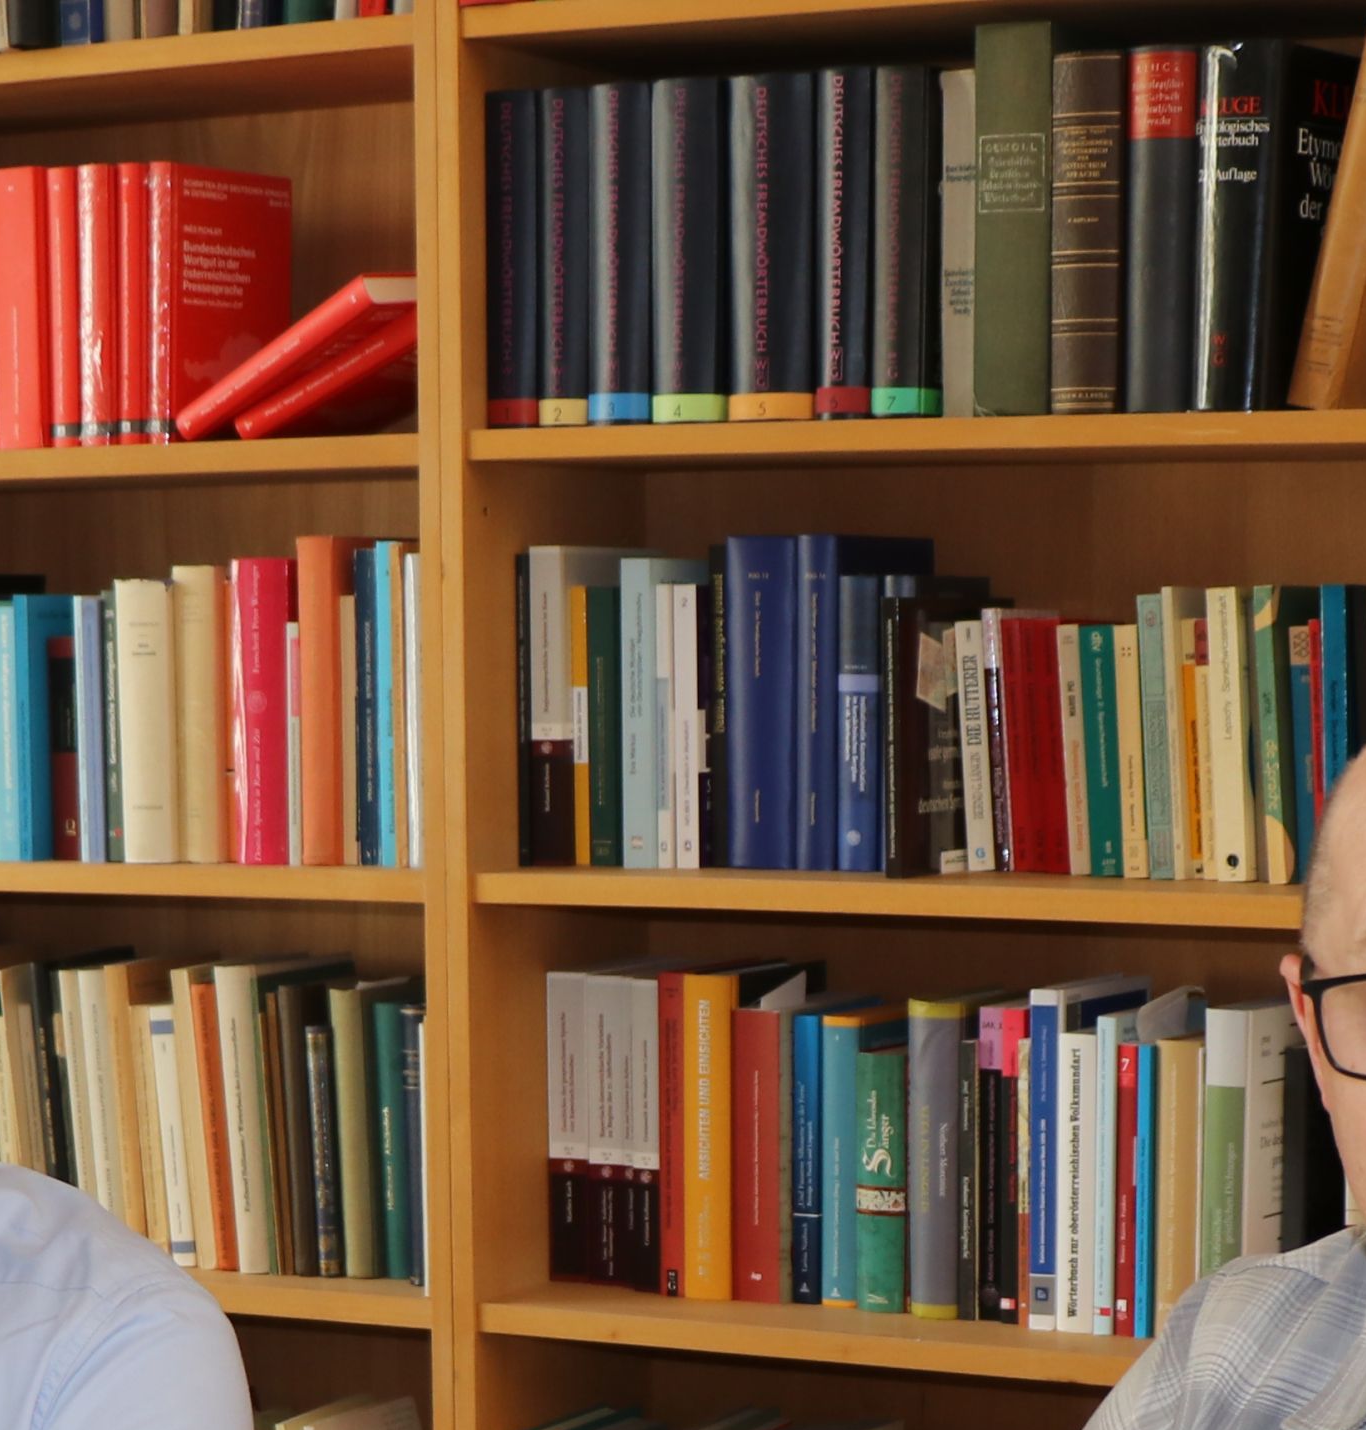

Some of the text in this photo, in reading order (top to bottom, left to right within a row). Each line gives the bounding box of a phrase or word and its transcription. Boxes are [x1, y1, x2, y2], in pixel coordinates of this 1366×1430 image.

[755, 86, 769, 353] DEUTSCHES FREMDWÖRTERBUCH
[830, 75, 843, 345] DEUTSCHES FREMDWÖRTERBUCH
[1299, 194, 1322, 220] der
[183, 240, 256, 259] Bundesdeutsches
[183, 254, 240, 271] Wortgut der
[183, 269, 251, 284] österreichischen
[183, 281, 243, 296] Pressesprache
[251, 608, 260, 629] Peter
[1217, 595, 1232, 692] Sprachwissenschaft
[962, 655, 983, 746] DIE HUTTERER
[1090, 630, 1109, 788] dtv Sprachwissenschaft
[106, 702, 117, 765] Germanistische
[1266, 762, 1281, 810] Sprache
[698, 999, 712, 1180] ANSICHTEN UND EINSICHTEN
[1121, 1058, 1130, 1071] 7
[861, 1113, 895, 1177] Sänger
[1223, 1142, 1237, 1195] Dichtungen
[987, 1133, 996, 1224] Deutsche Kanzleisprachen
[1066, 1048, 1081, 1318] Wörterbuch zur oberösterreichischen Volksmundart
